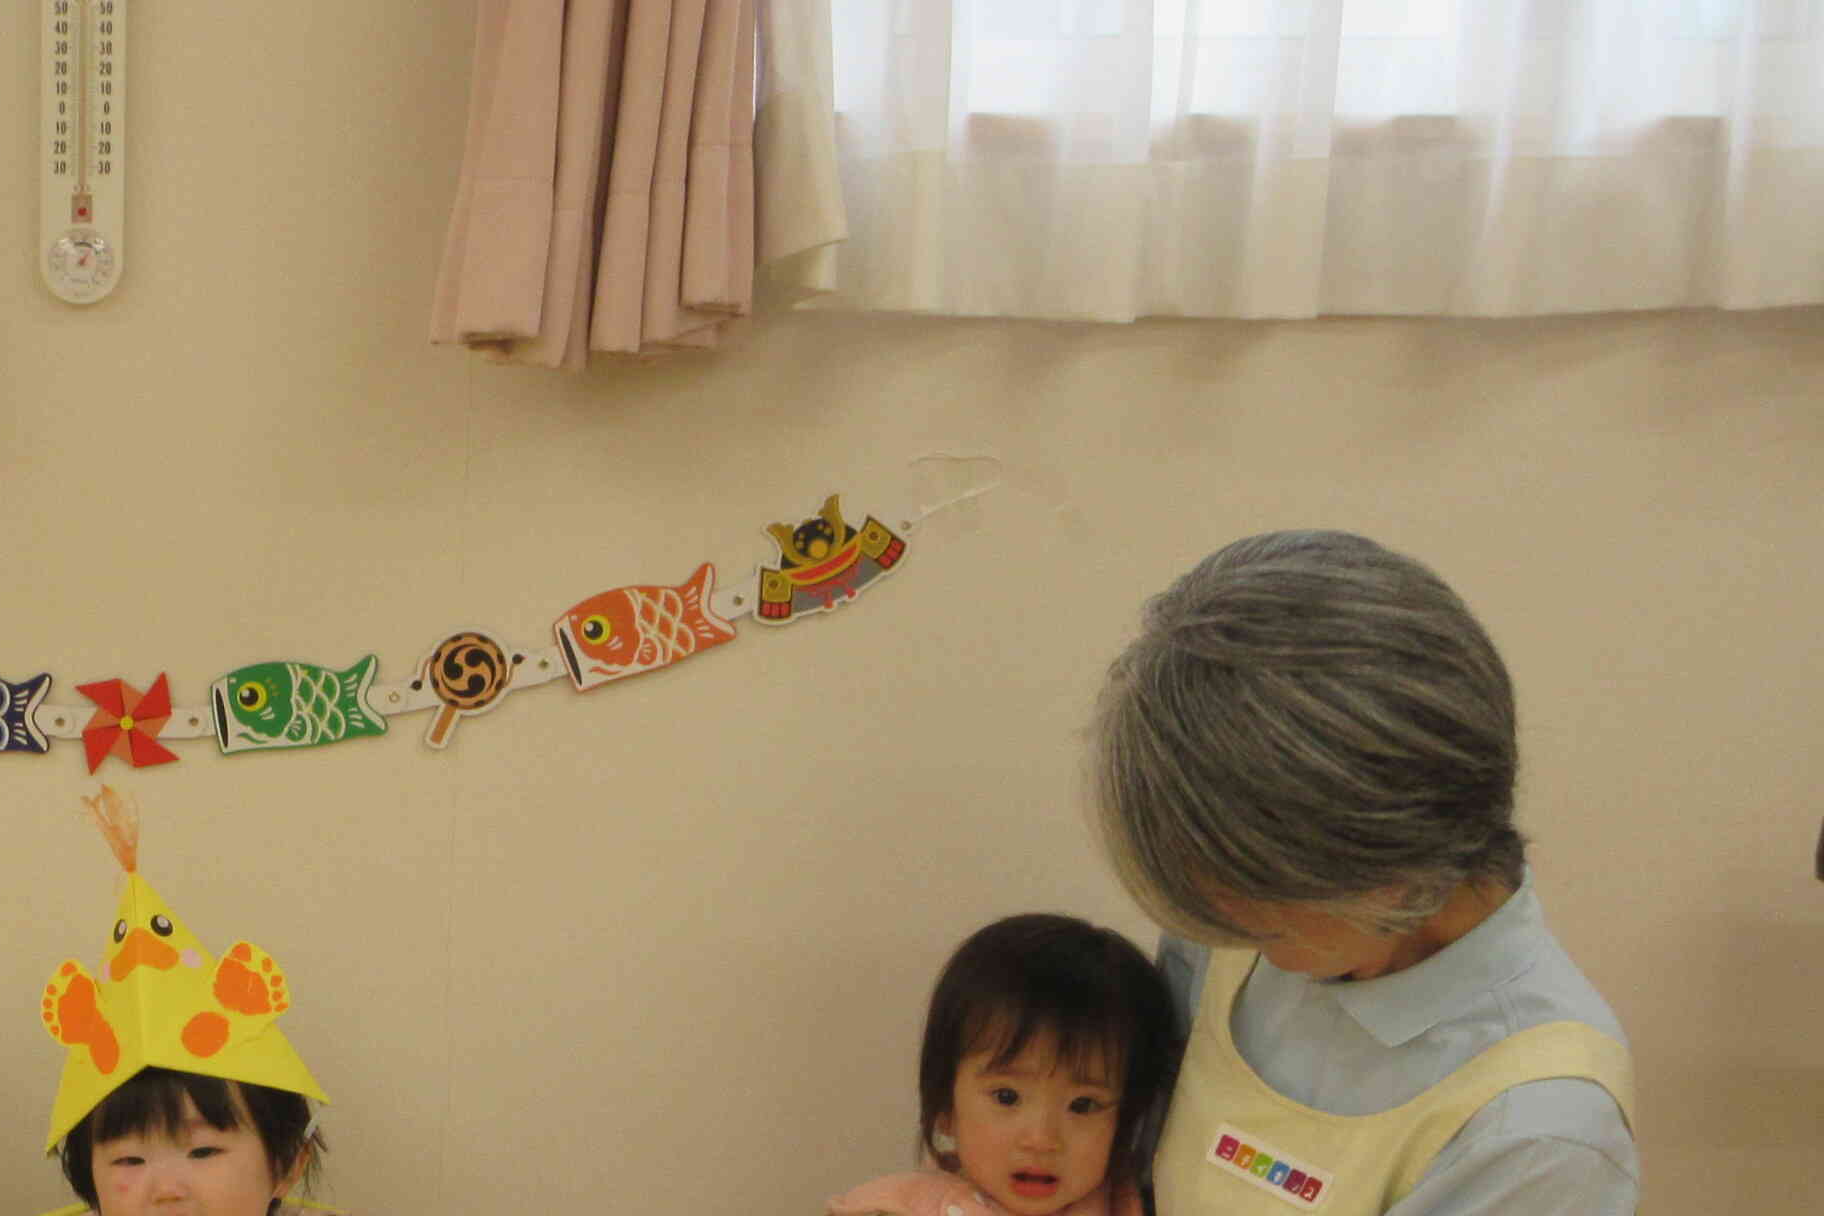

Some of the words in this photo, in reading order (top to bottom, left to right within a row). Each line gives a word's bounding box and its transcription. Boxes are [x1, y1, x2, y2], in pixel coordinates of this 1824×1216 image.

[55, 20, 68, 35] 40
[100, 20, 113, 35] 40
[55, 40, 68, 55] 30
[100, 40, 113, 55] 30
[55, 61, 68, 76] 20
[99, 61, 112, 76] 20
[56, 80, 67, 95] 10
[100, 81, 112, 96] 10
[59, 101, 66, 115] 0
[103, 101, 110, 115] 0
[56, 121, 67, 135] 10
[100, 121, 112, 136] 10
[54, 141, 66, 155] 20
[98, 141, 111, 155] 20
[54, 161, 66, 175] 30
[97, 161, 111, 175] 30
